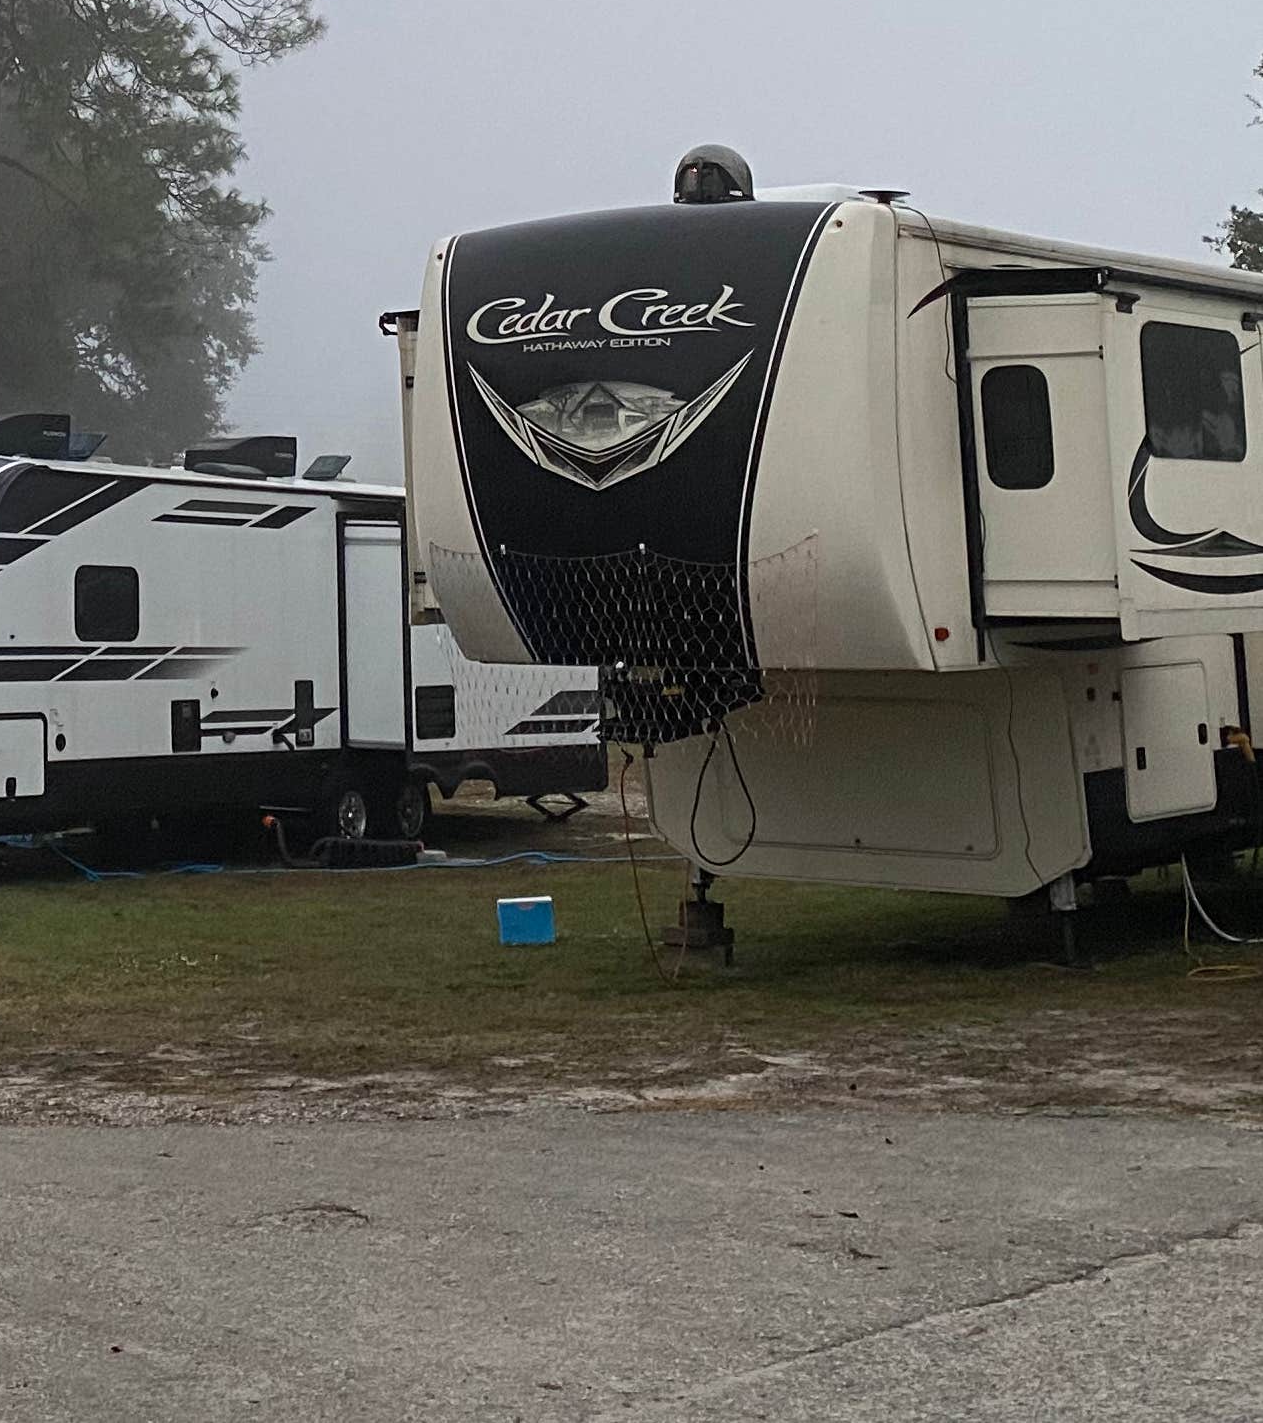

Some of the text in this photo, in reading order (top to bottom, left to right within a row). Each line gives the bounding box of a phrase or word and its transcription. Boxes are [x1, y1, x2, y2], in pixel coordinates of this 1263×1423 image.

[466, 284, 756, 344] Cedar Creek
[523, 337, 671, 353] HATHAWAY EDITION
